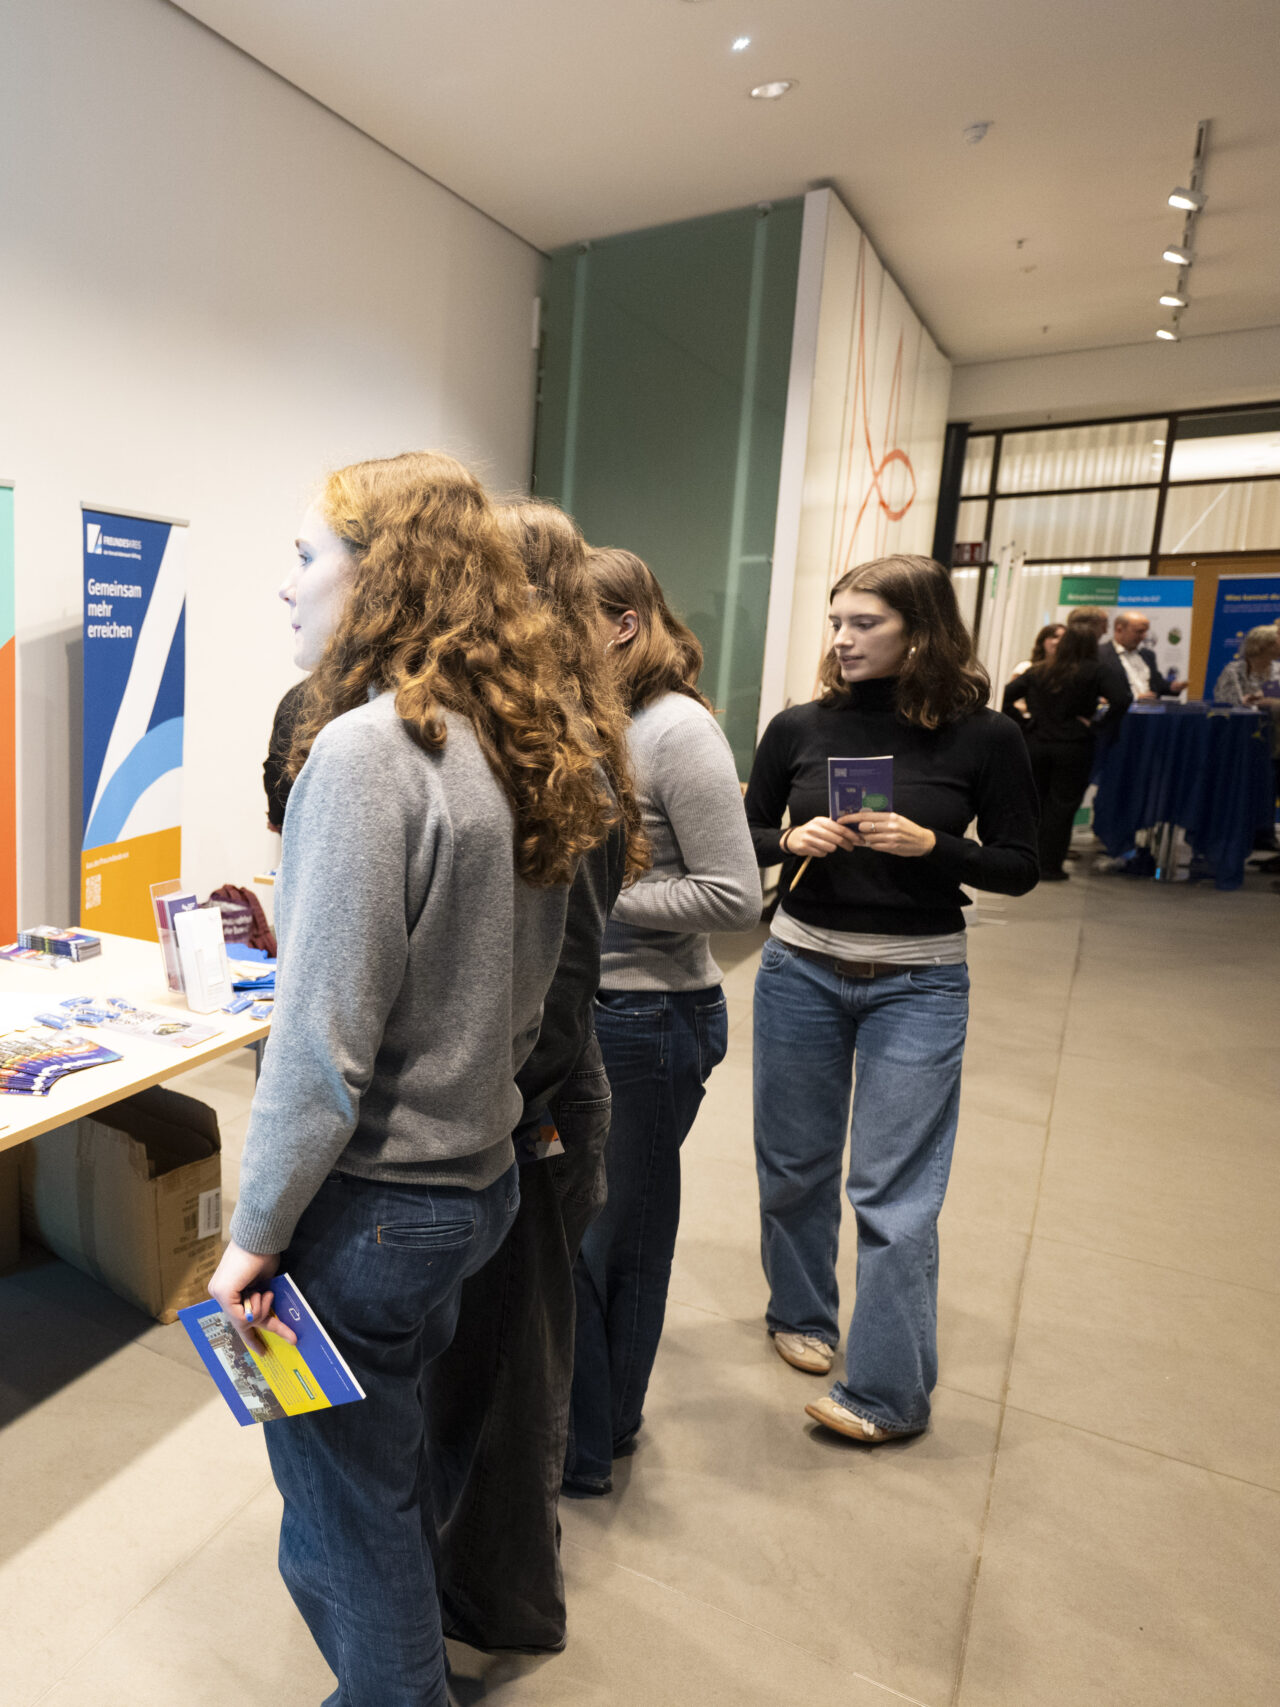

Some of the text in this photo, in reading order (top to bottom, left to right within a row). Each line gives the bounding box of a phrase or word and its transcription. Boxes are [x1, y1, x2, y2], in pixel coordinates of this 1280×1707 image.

[88, 578, 142, 598] Gemeinsam
[88, 600, 113, 617] mehr
[88, 622, 132, 638] erreichen
